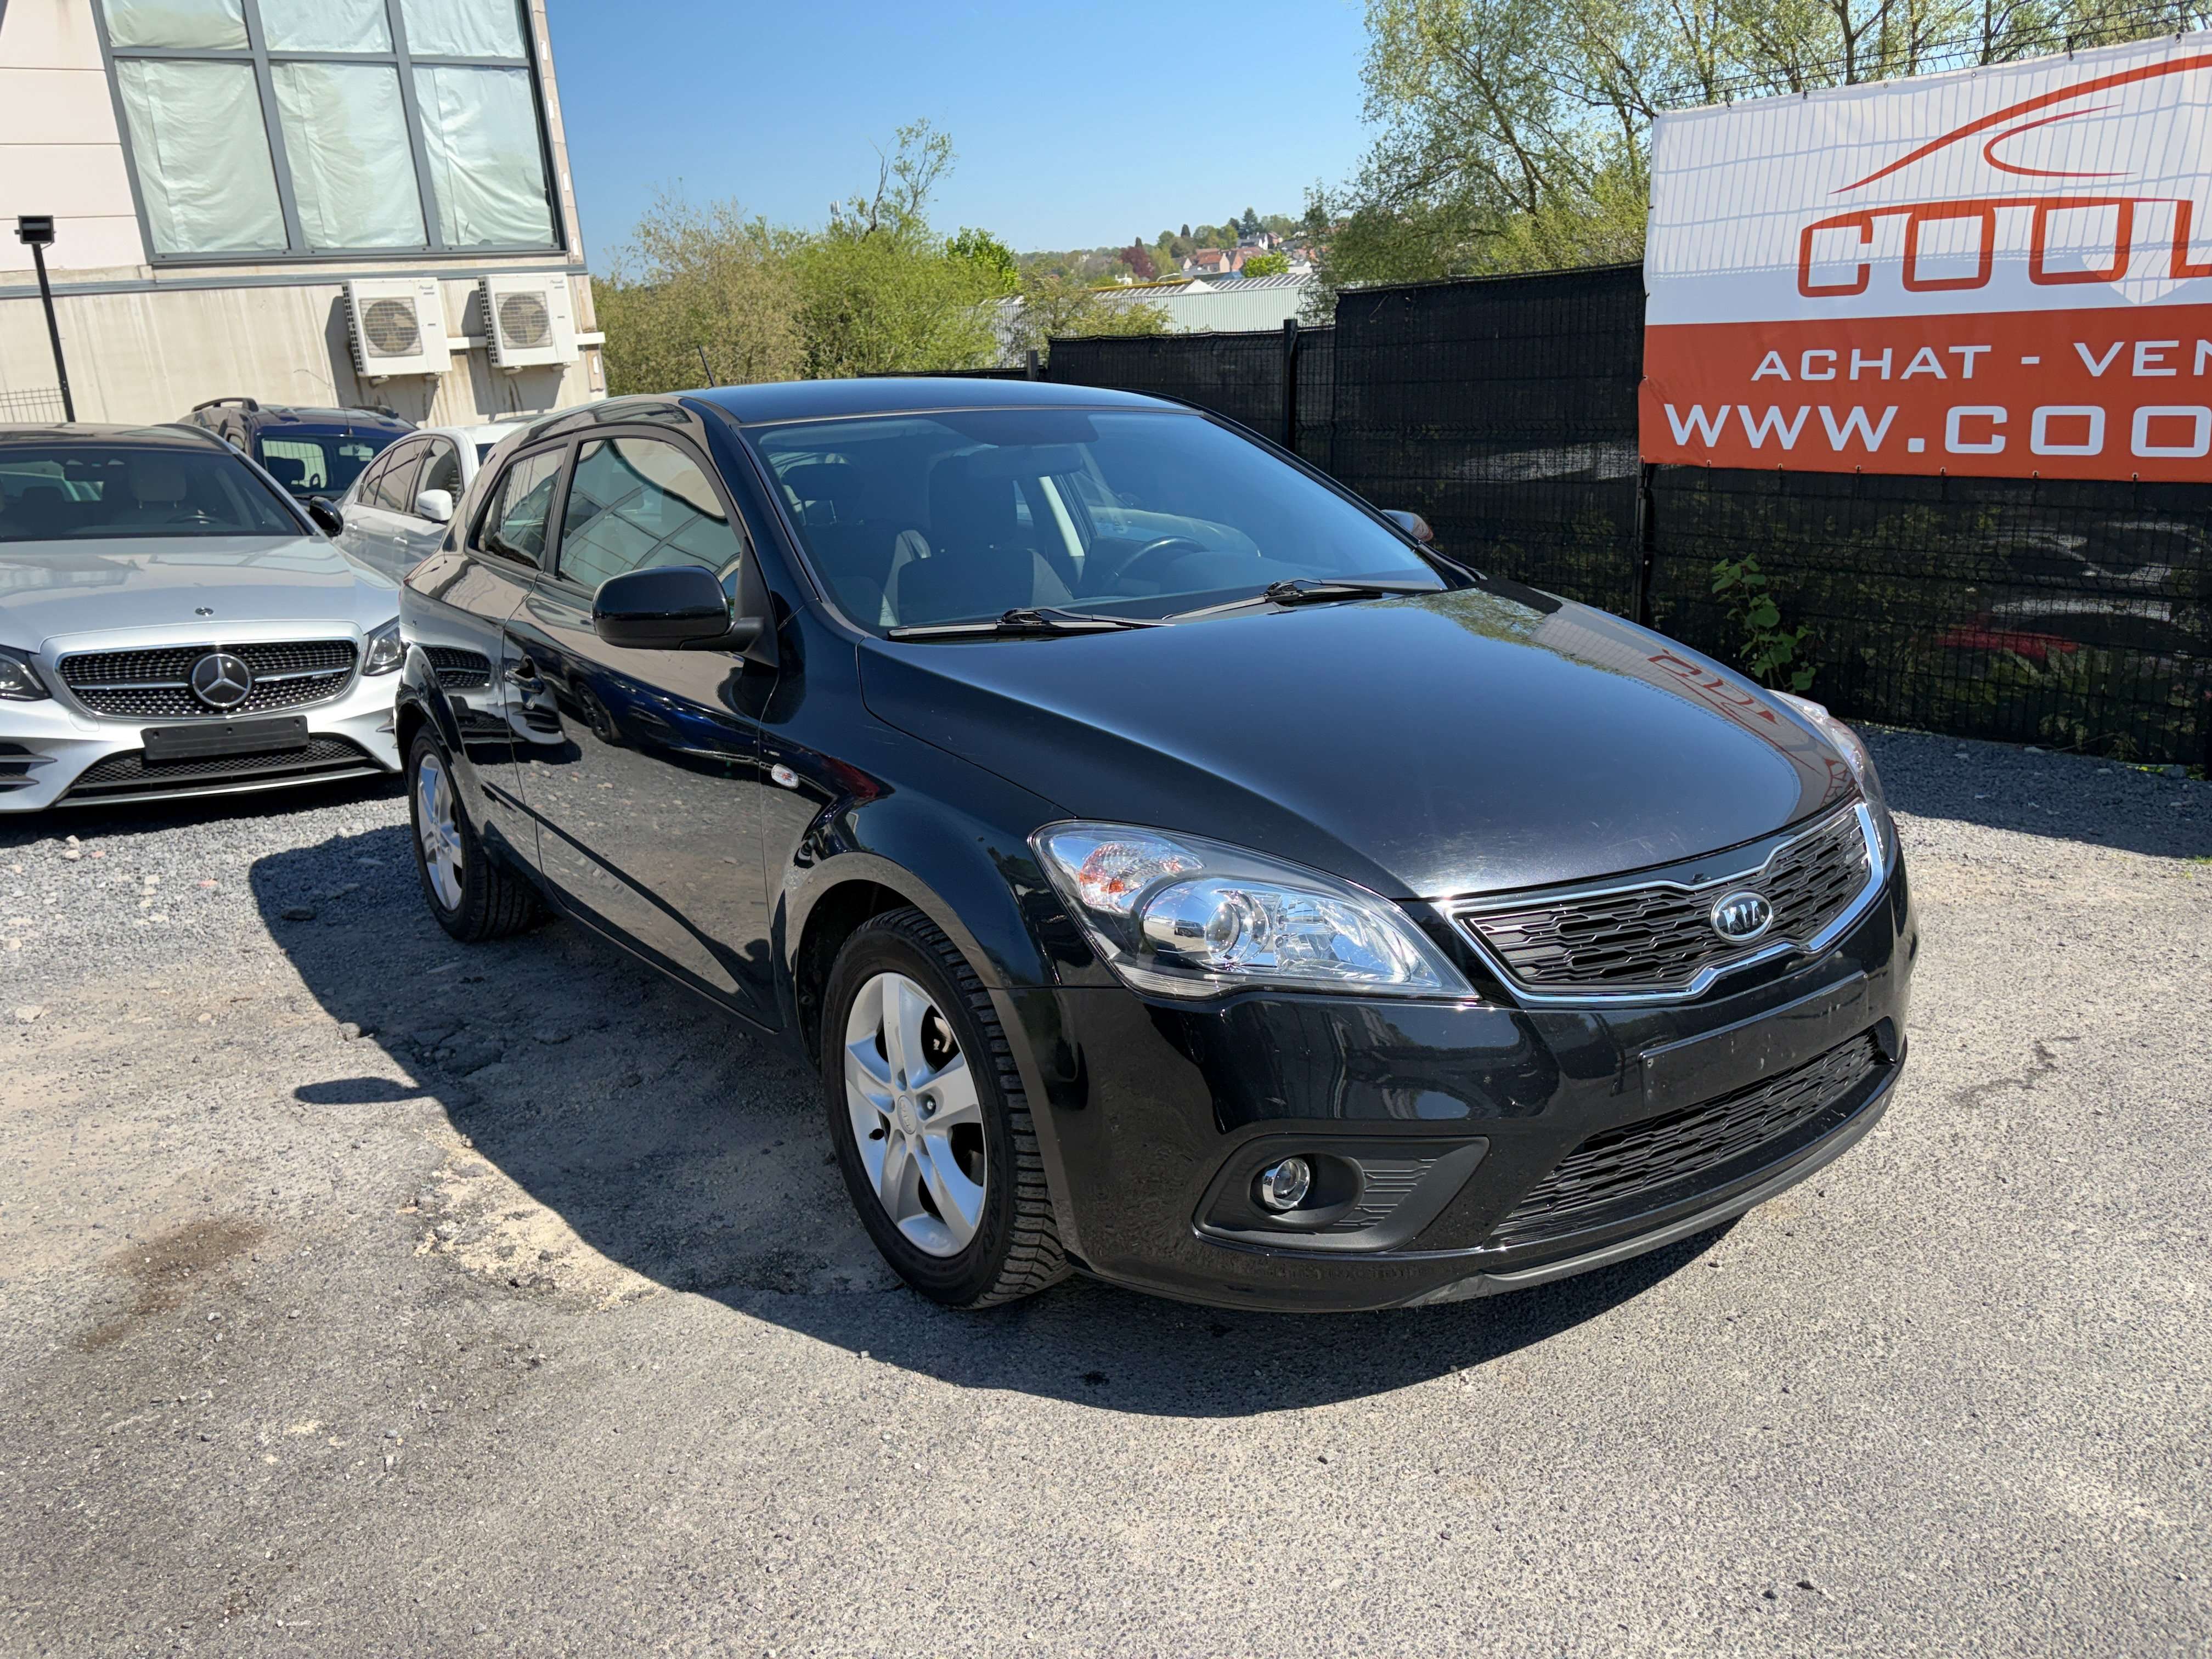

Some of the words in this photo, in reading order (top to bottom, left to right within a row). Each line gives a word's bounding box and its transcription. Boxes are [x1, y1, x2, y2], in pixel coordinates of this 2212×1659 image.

[1751, 345, 1991, 381] ACHAT
[2021, 356, 2040, 364] -
[1664, 404, 2212, 458] WWW.COO
[1722, 900, 1766, 933] KIA
